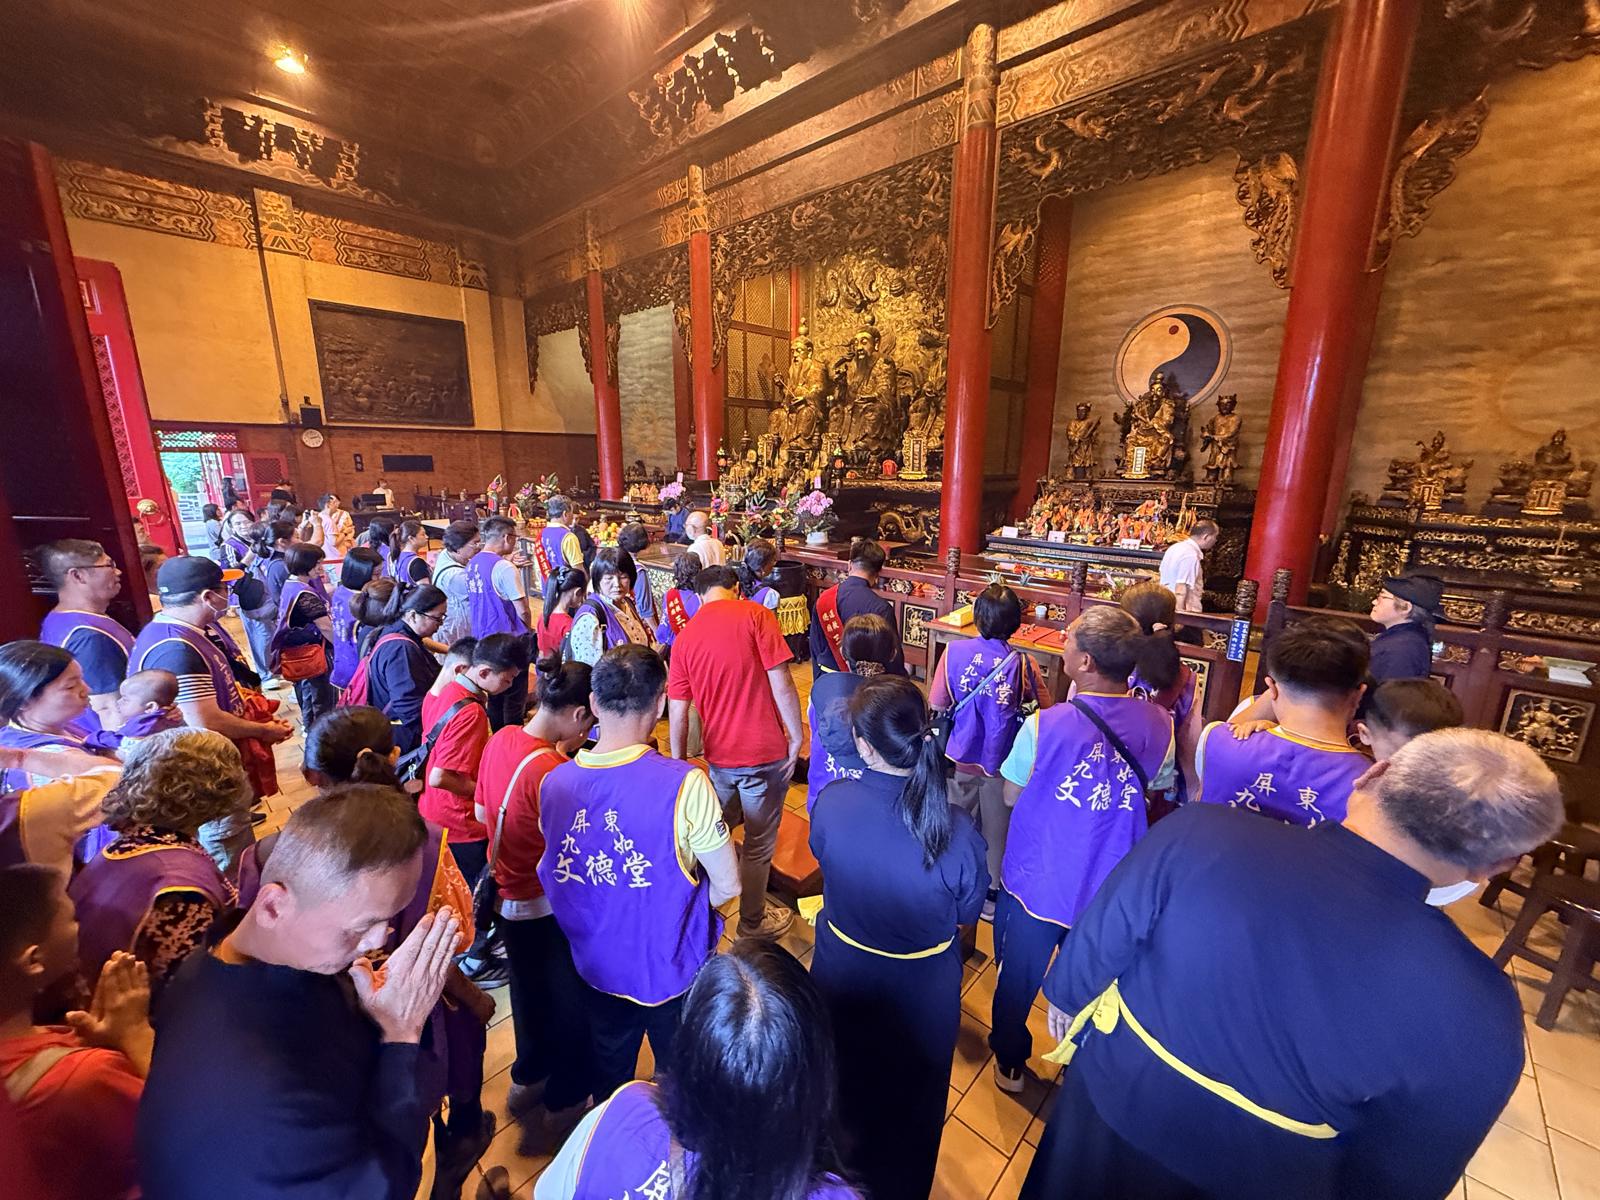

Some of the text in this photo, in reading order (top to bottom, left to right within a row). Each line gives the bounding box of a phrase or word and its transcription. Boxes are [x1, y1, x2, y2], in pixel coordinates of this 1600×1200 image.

[964, 664, 1007, 683] 九如
[1055, 775, 1138, 812] 文德堂
[1250, 772, 1322, 813] 屏東
[569, 808, 621, 833] 屏東
[560, 833, 634, 856] 九如
[552, 850, 653, 889] 文德堂
